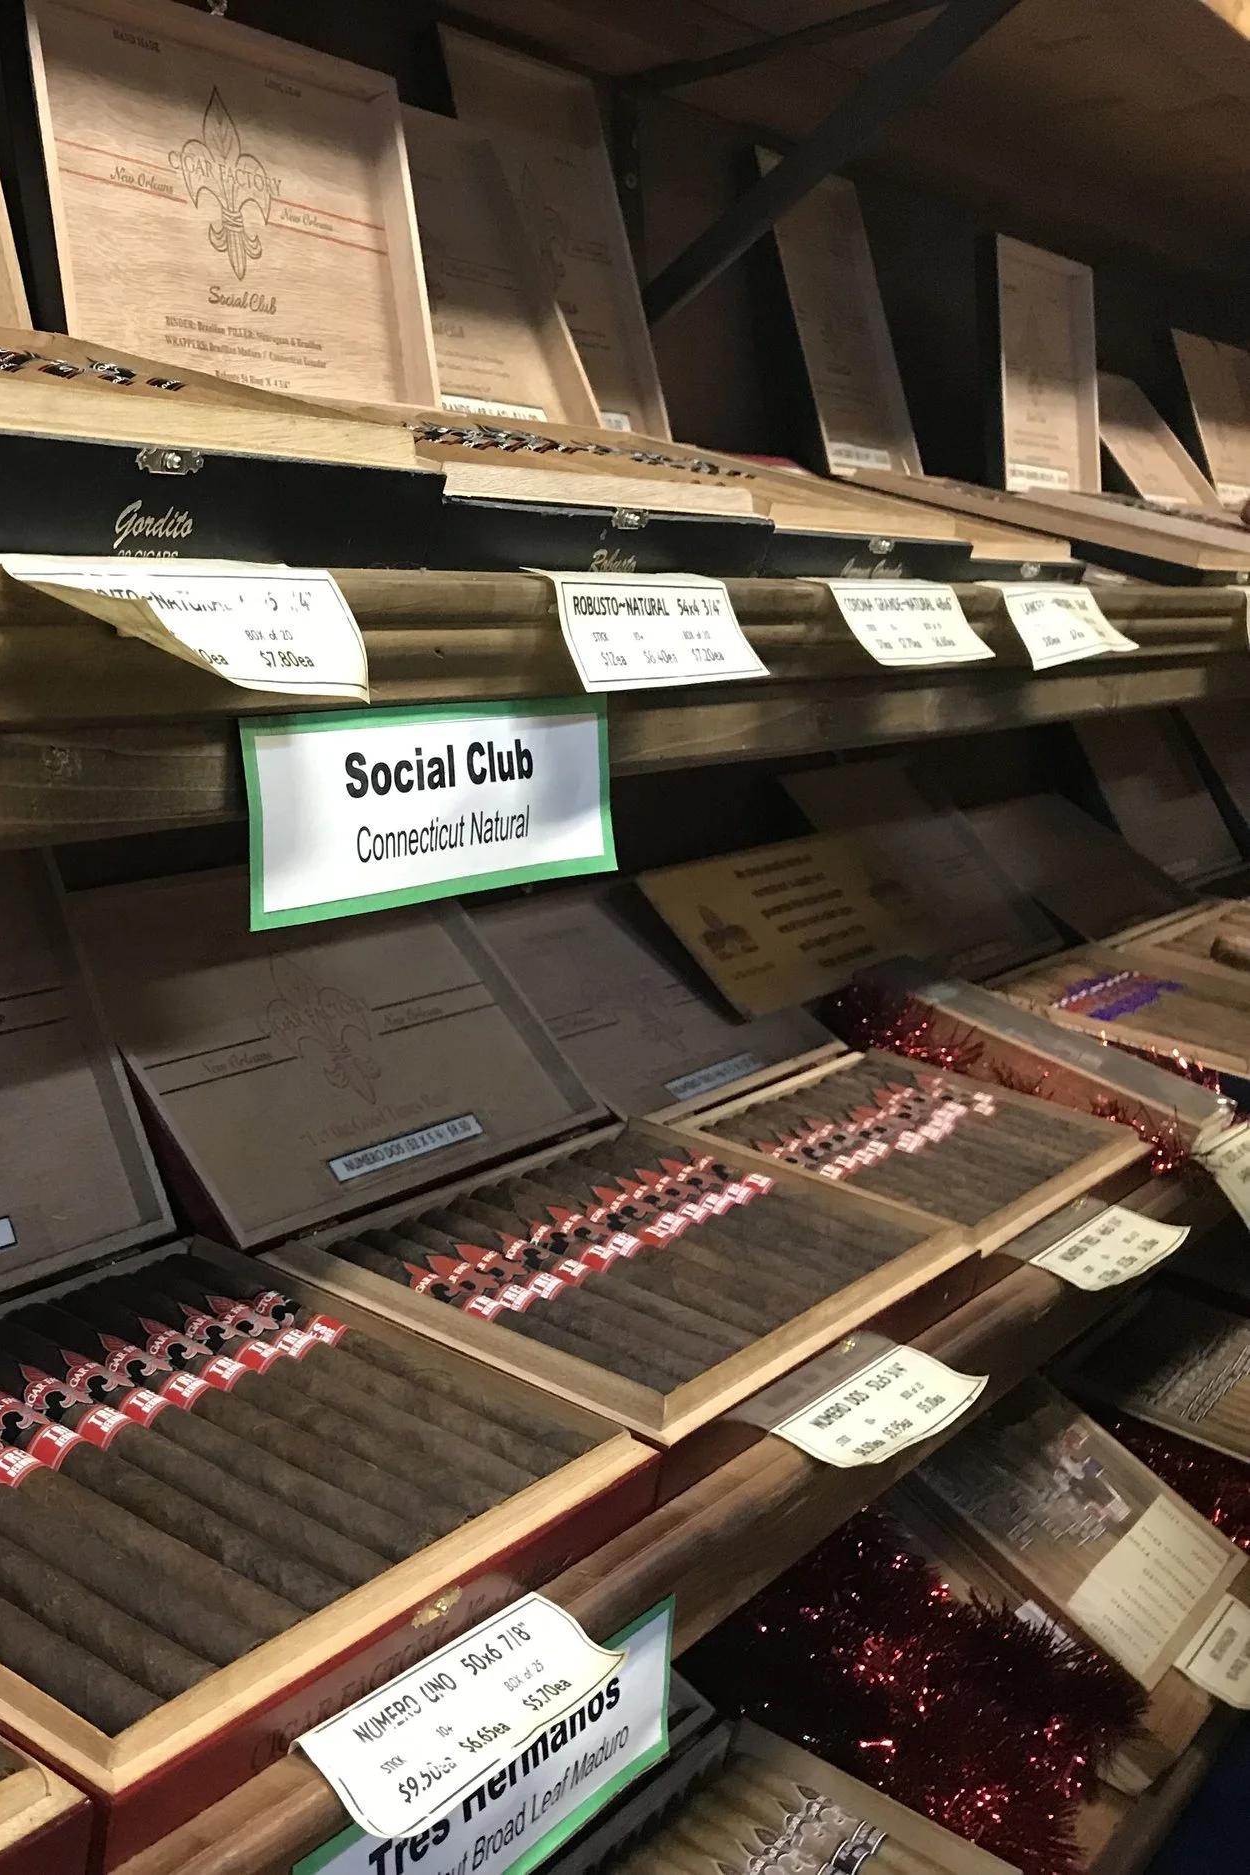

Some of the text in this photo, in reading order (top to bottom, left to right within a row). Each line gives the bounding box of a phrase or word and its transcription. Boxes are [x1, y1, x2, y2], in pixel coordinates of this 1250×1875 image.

[110, 166, 174, 195] New Orleans
[168, 150, 282, 198] CIGAR FACTORY
[208, 285, 277, 316] Social Club
[113, 499, 194, 549] Gordito
[572, 595, 670, 616] ROBUSTO~NATURAL
[245, 629, 265, 641] BOX
[280, 629, 293, 641] 20
[259, 649, 315, 668] $7.80ea
[345, 739, 534, 798] Social Club
[356, 805, 530, 863] Connecticut Natural
[808, 1401, 852, 1430] NUMERO
[352, 1693, 422, 1745] NUMERO
[418, 1671, 458, 1704] UNO
[459, 1642, 504, 1677] 50x6
[379, 1753, 408, 1775] STICK
[503, 1674, 525, 1693] BOX
[533, 1658, 545, 1674] 25
[458, 1720, 512, 1754] $6.65ea
[521, 1677, 573, 1713] $5.70ea
[471, 1724, 631, 1873] Broad Leaf Maduro
[367, 1815, 452, 1875] Tres
